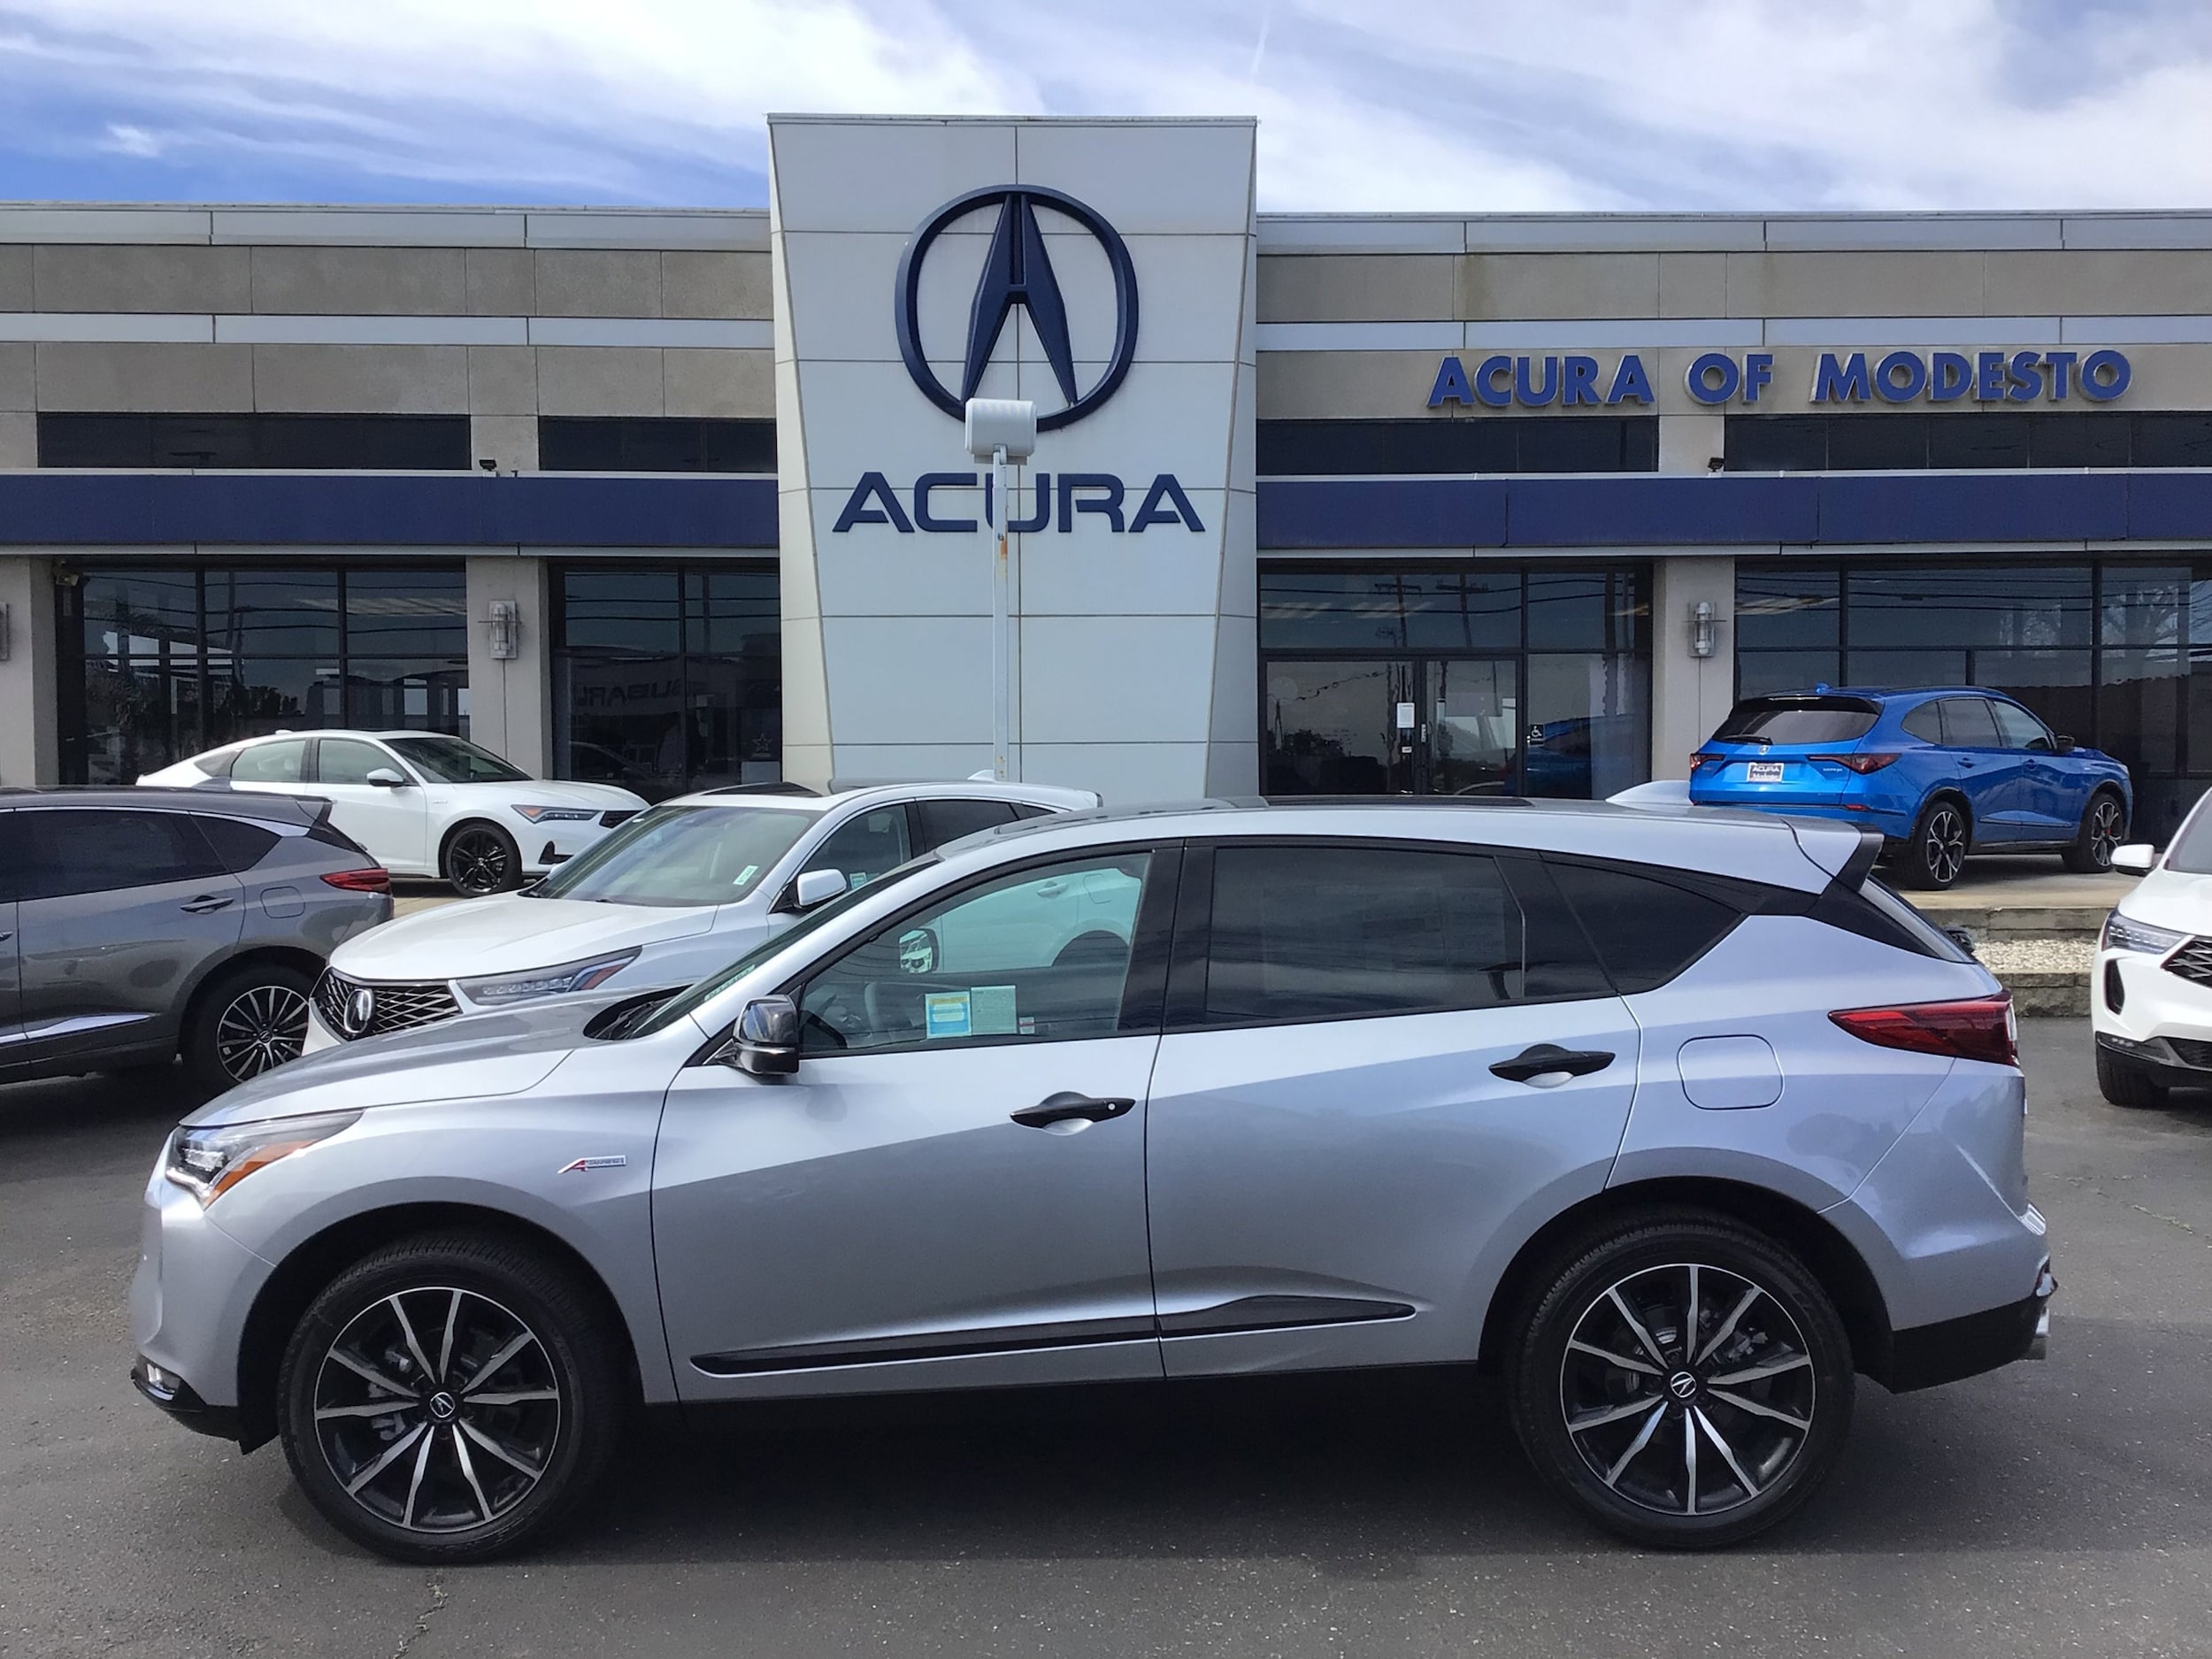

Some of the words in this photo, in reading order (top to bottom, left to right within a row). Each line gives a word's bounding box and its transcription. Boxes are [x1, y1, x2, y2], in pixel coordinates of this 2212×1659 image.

[1427, 354, 1655, 407] ACURA
[1685, 352, 1774, 405] OF
[1809, 349, 2131, 403] MODESTO
[832, 472, 1206, 533] ACURA
